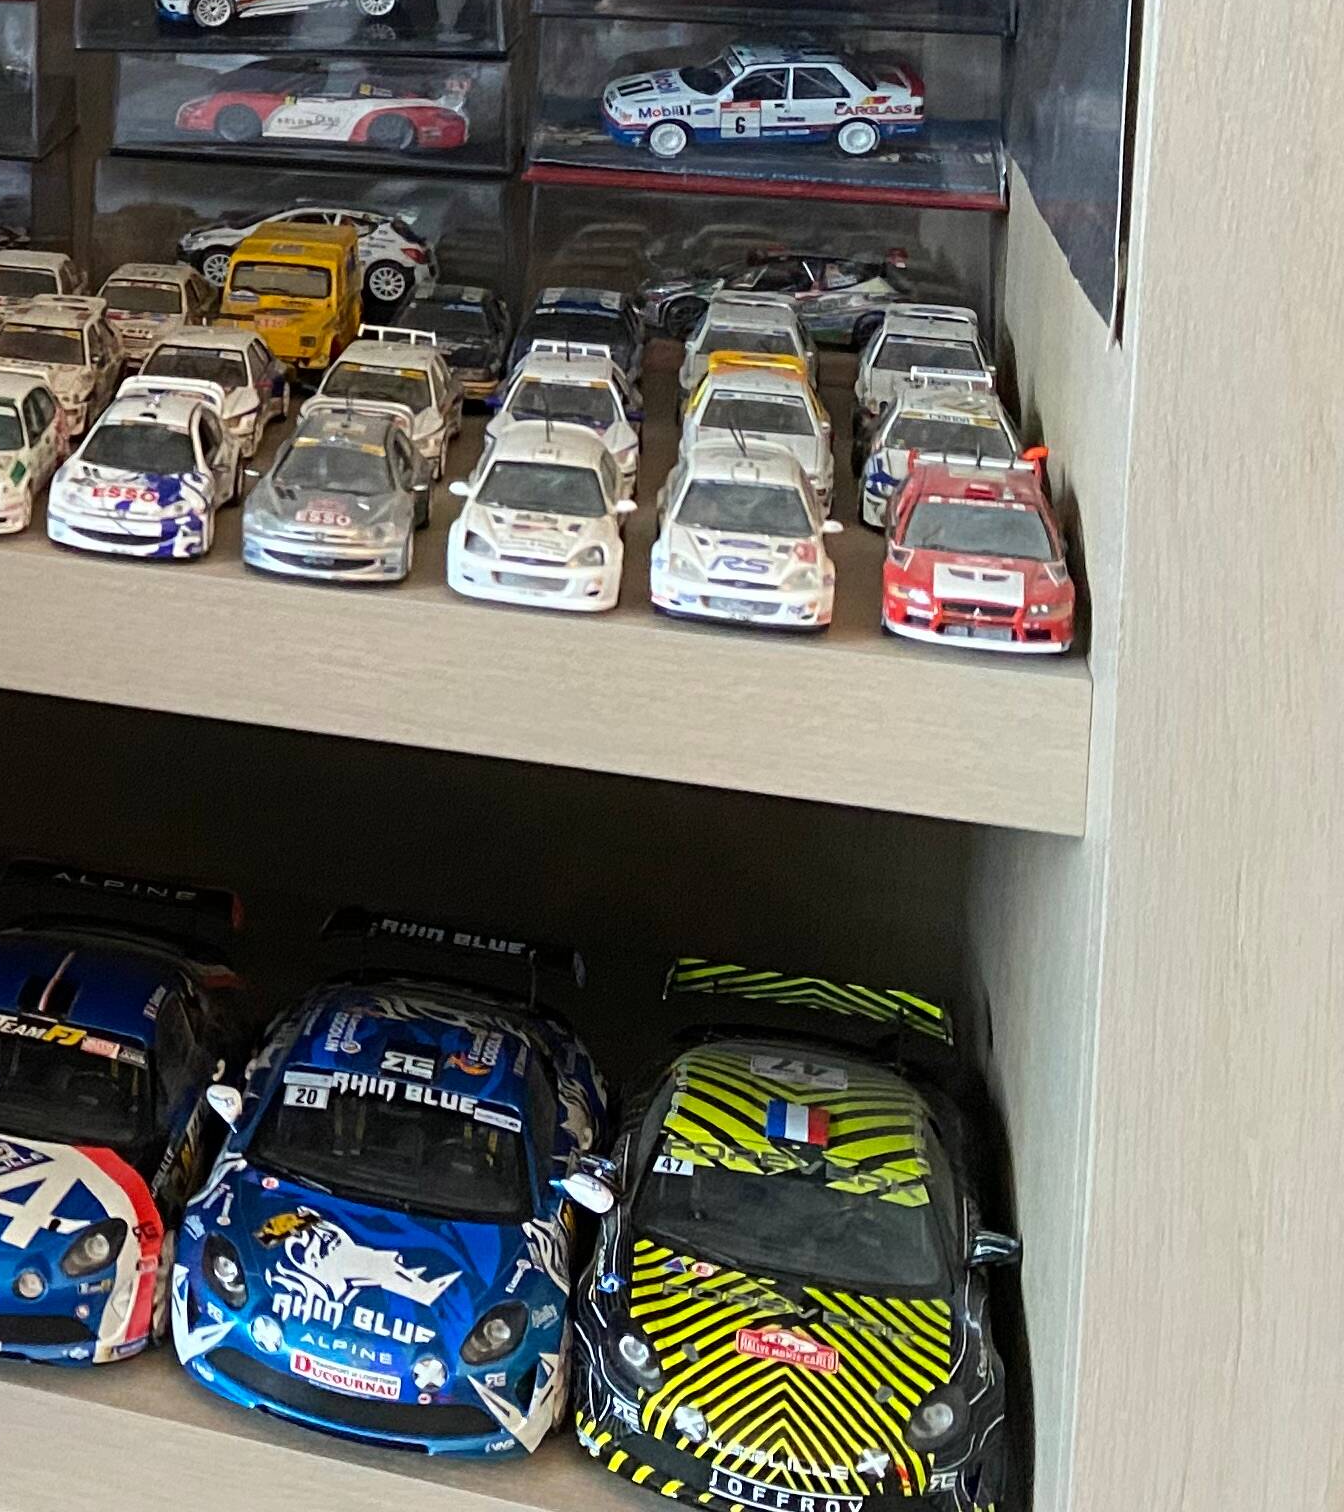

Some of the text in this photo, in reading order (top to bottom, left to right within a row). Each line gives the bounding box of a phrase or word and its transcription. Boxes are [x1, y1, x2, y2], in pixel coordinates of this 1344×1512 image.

[834, 104, 913, 116] CARGLASS
[734, 116, 746, 136] 6
[92, 486, 160, 502] ESSO
[295, 509, 351, 527] ESSO
[709, 555, 771, 575] RS
[54, 871, 197, 901] ALPINE
[453, 932, 527, 955] BLUE
[295, 1087, 318, 1106] 20
[331, 1071, 479, 1115] RHIN BLUE
[662, 1158, 684, 1172] 47
[272, 1292, 437, 1345] RHIN BLUE
[299, 1332, 394, 1366] ALPINE
[294, 1350, 399, 1400] DUCOURNAU
[710, 1467, 864, 1512] JOFFROY
